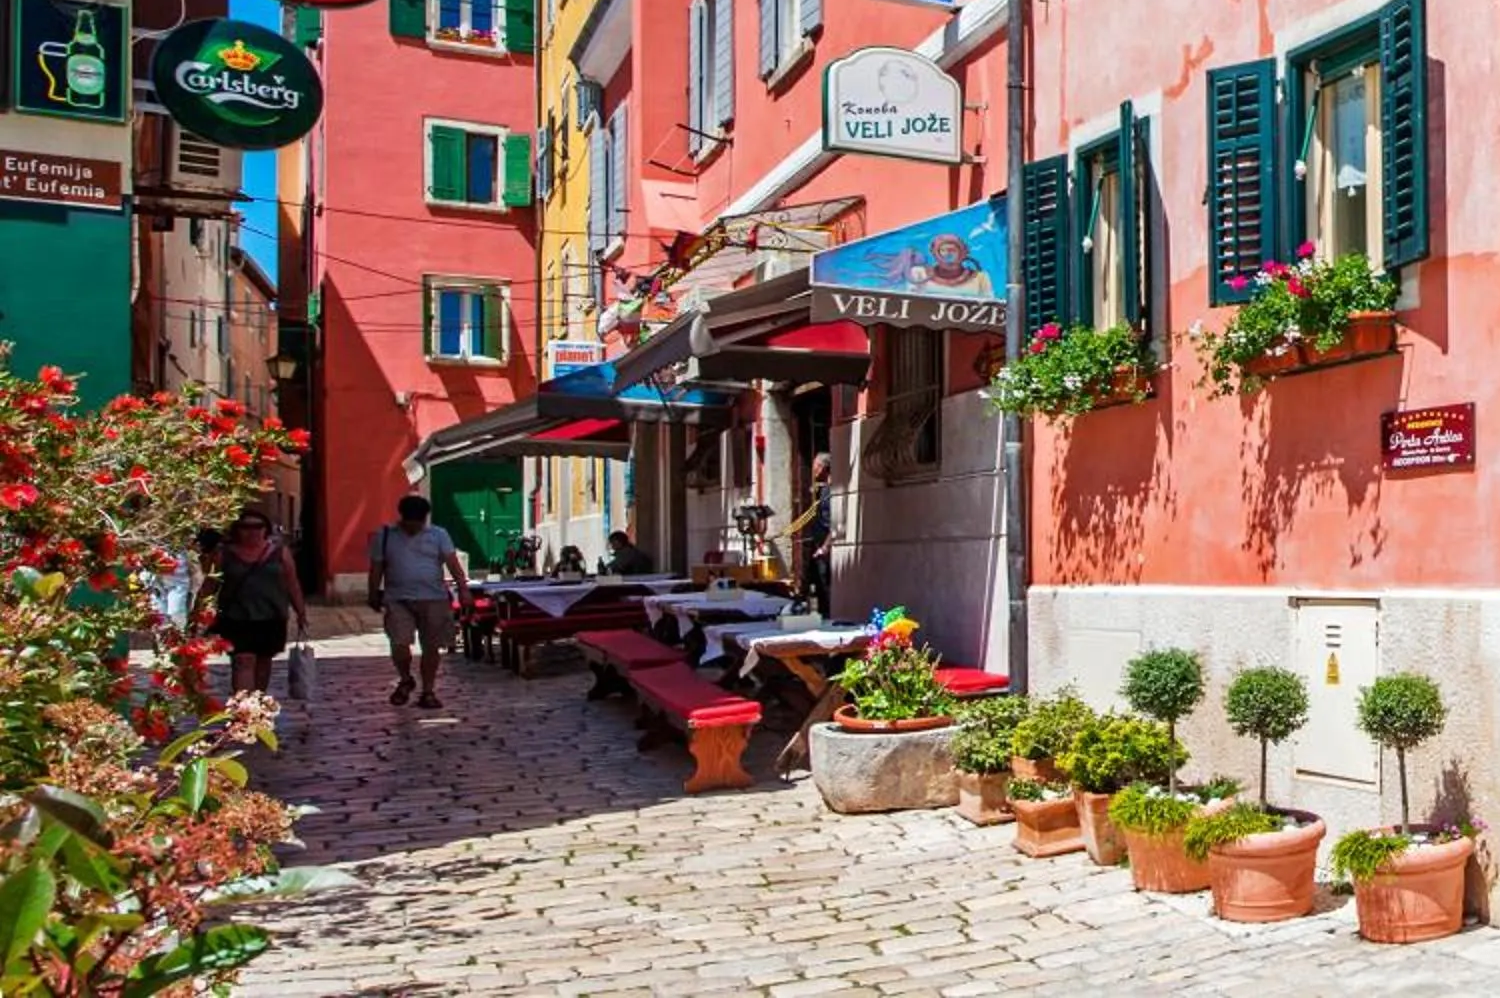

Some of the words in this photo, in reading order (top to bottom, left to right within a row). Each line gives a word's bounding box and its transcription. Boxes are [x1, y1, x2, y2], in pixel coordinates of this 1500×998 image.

[175, 60, 300, 109] Carlsberg
[842, 101, 898, 115] Konoba
[845, 120, 893, 139] VELI
[901, 111, 951, 135] JOŽE
[5, 156, 93, 180] Eufemija
[25, 177, 105, 199] Eufemia
[831, 293, 910, 319] VELI
[930, 298, 1007, 326] JOŽE
